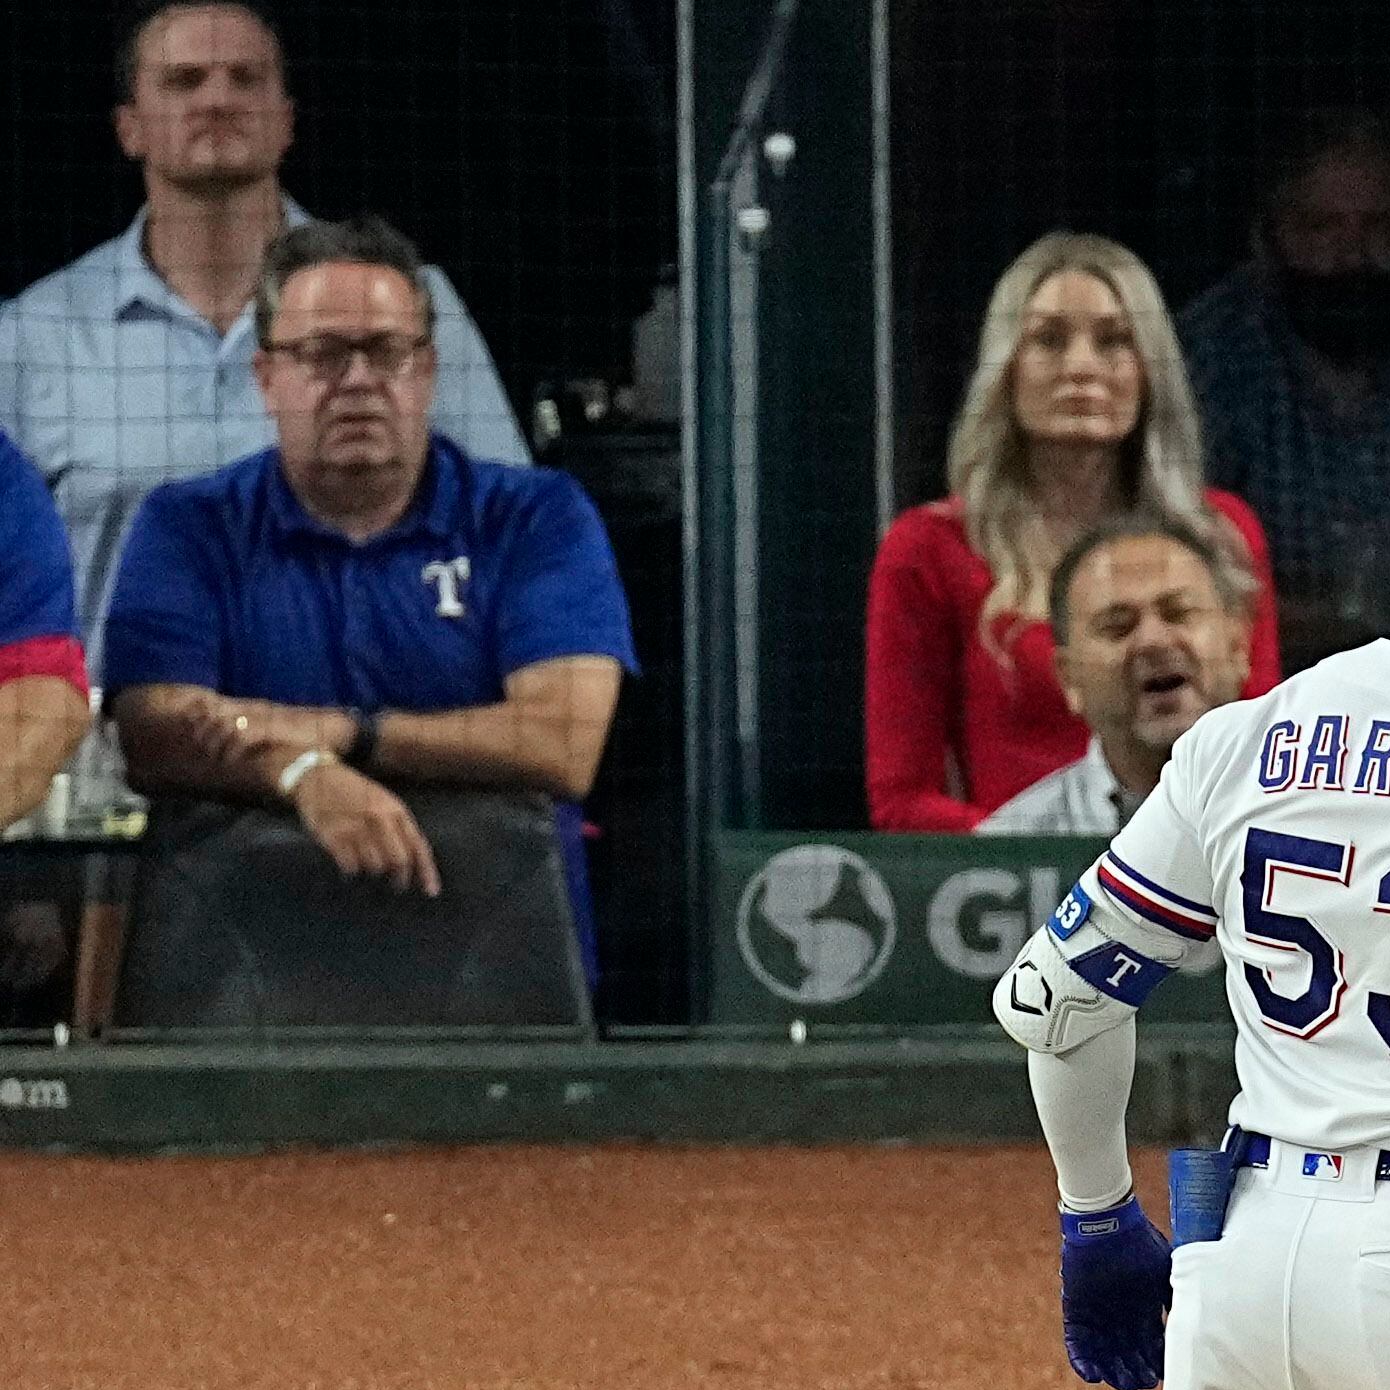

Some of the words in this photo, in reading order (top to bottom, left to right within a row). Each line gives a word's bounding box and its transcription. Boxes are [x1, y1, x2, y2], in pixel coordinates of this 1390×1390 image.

[420, 555, 471, 617] T
[1055, 892, 1082, 930] 53
[1105, 952, 1143, 988] T
